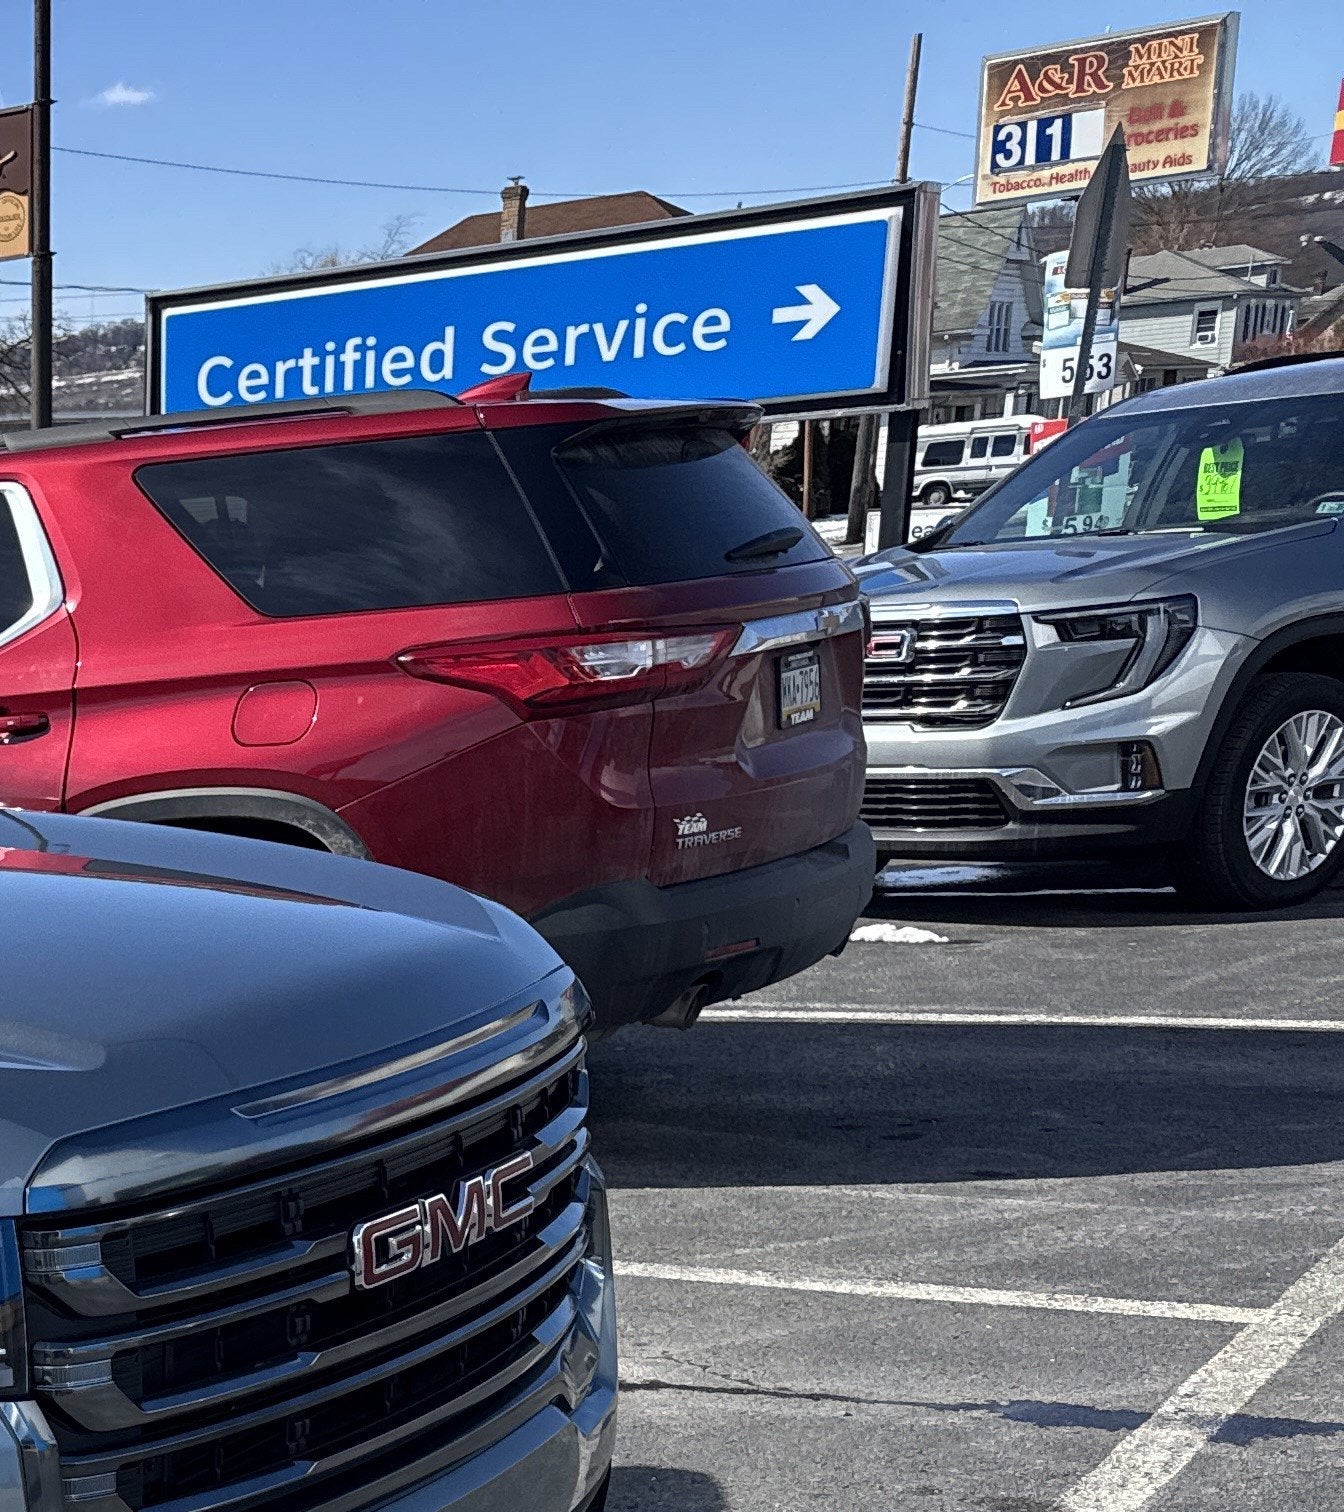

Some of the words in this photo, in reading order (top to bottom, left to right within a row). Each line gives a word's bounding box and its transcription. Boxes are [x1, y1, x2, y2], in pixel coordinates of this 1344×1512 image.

[1129, 33, 1200, 65] MINI
[994, 51, 1113, 111] A&R
[1122, 55, 1204, 89] MART
[1126, 122, 1199, 147] roceries
[1050, 167, 1091, 186] Health
[1162, 153, 1193, 168] Aids
[197, 326, 455, 407] Certified
[480, 302, 732, 376] Service
[676, 826, 742, 850] TRAVERSE
[353, 1151, 534, 1289] GMC
